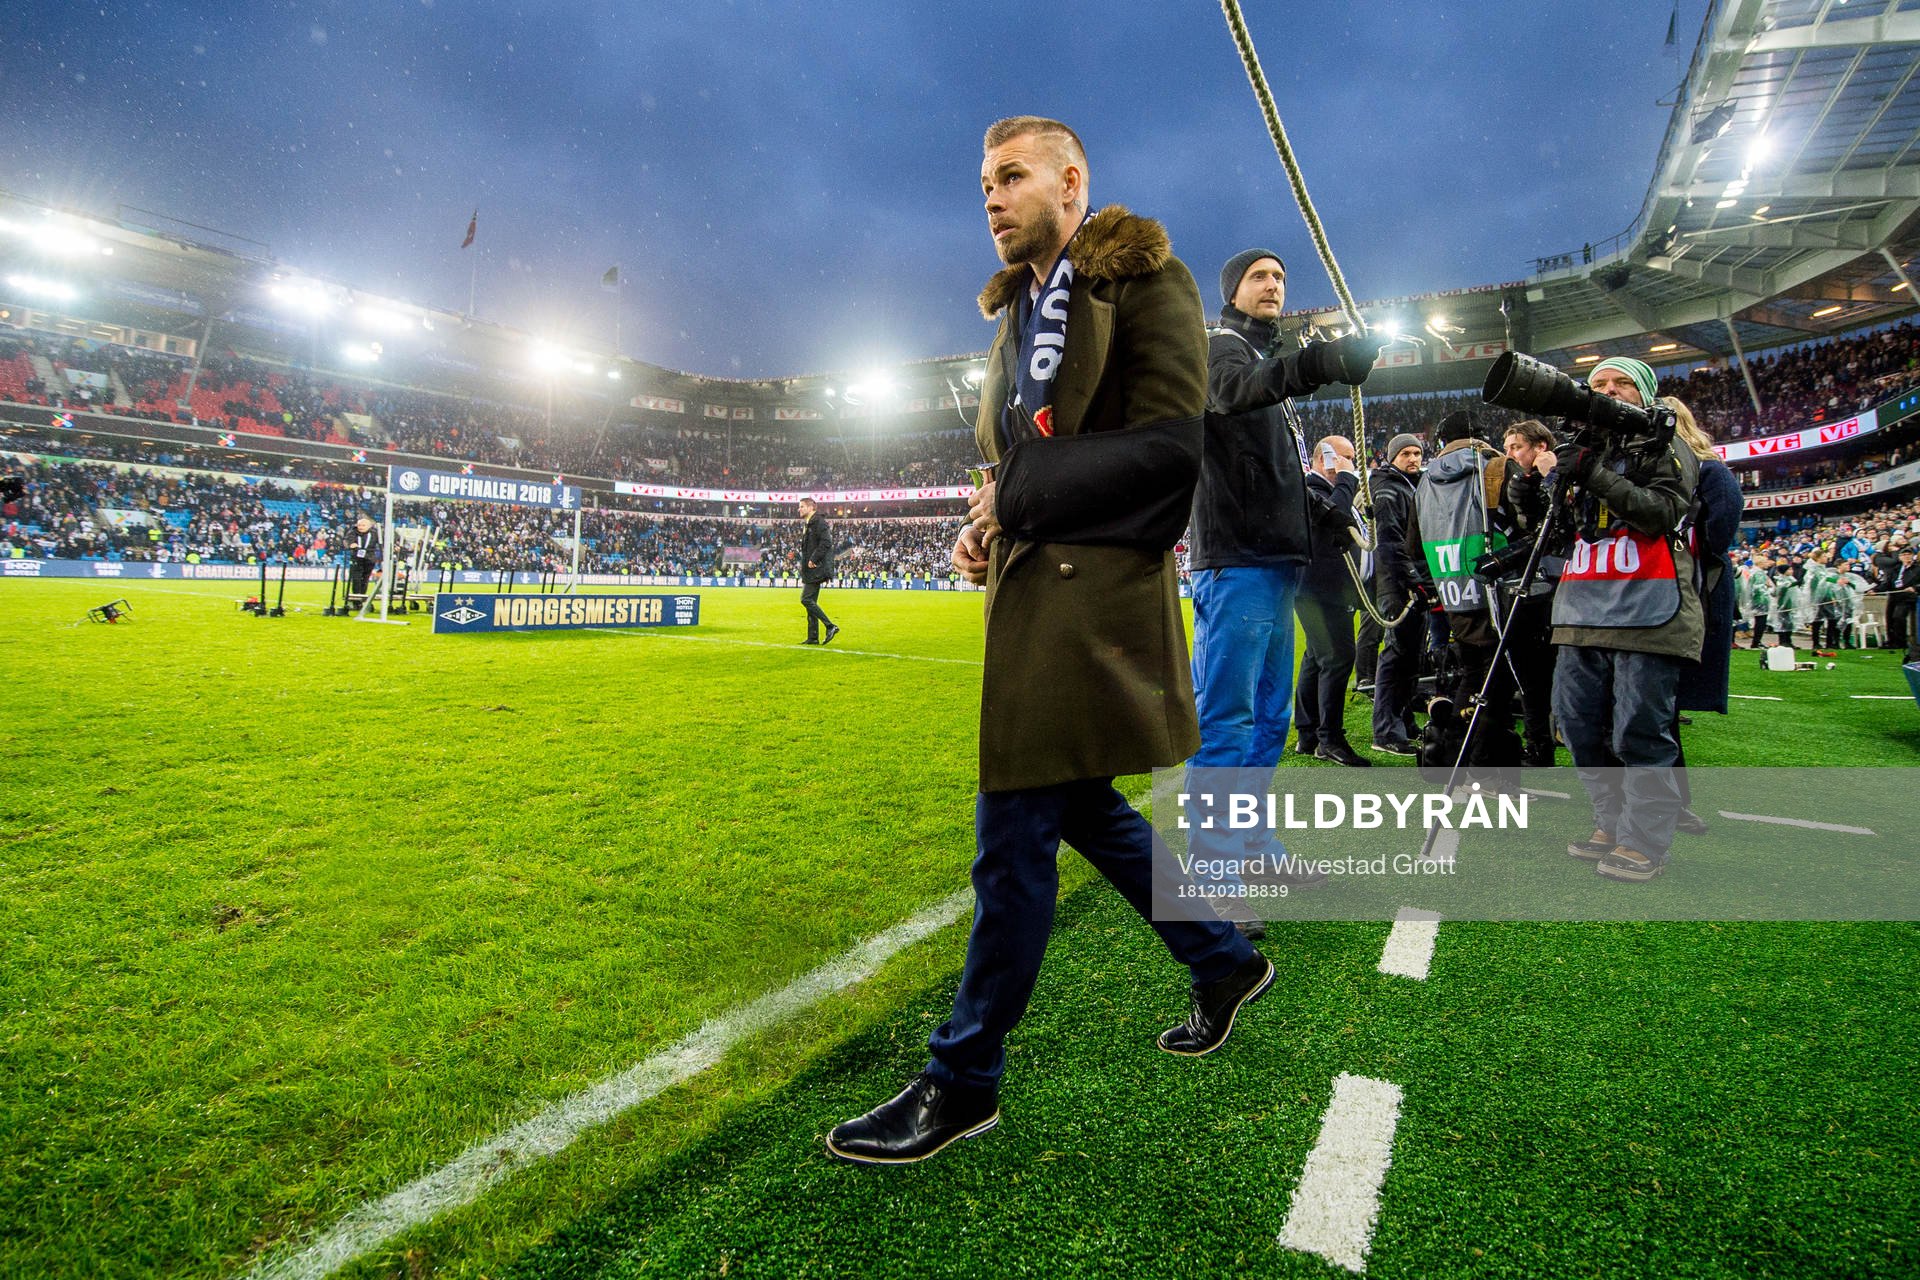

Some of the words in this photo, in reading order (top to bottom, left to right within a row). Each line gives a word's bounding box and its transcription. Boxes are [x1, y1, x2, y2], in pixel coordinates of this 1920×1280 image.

[1440, 341, 1507, 362] VG
[1749, 433, 1801, 456] VG
[1820, 418, 1859, 443] VG
[429, 474, 517, 501] CUPFINALEN
[520, 484, 552, 504] 2018
[633, 484, 664, 497] VG
[678, 488, 710, 499] VG
[724, 491, 755, 501] VG
[769, 491, 798, 502] VG
[846, 491, 870, 501] VG
[881, 489, 907, 500] VG
[919, 487, 946, 498] VG
[1775, 493, 1809, 507] VG
[1813, 487, 1845, 501] VG
[1848, 480, 1873, 496] VG
[1435, 544, 1461, 573] TV
[1563, 536, 1640, 575] OTO
[1439, 579, 1481, 606] 104
[494, 598, 663, 626] NORGESMESTER
